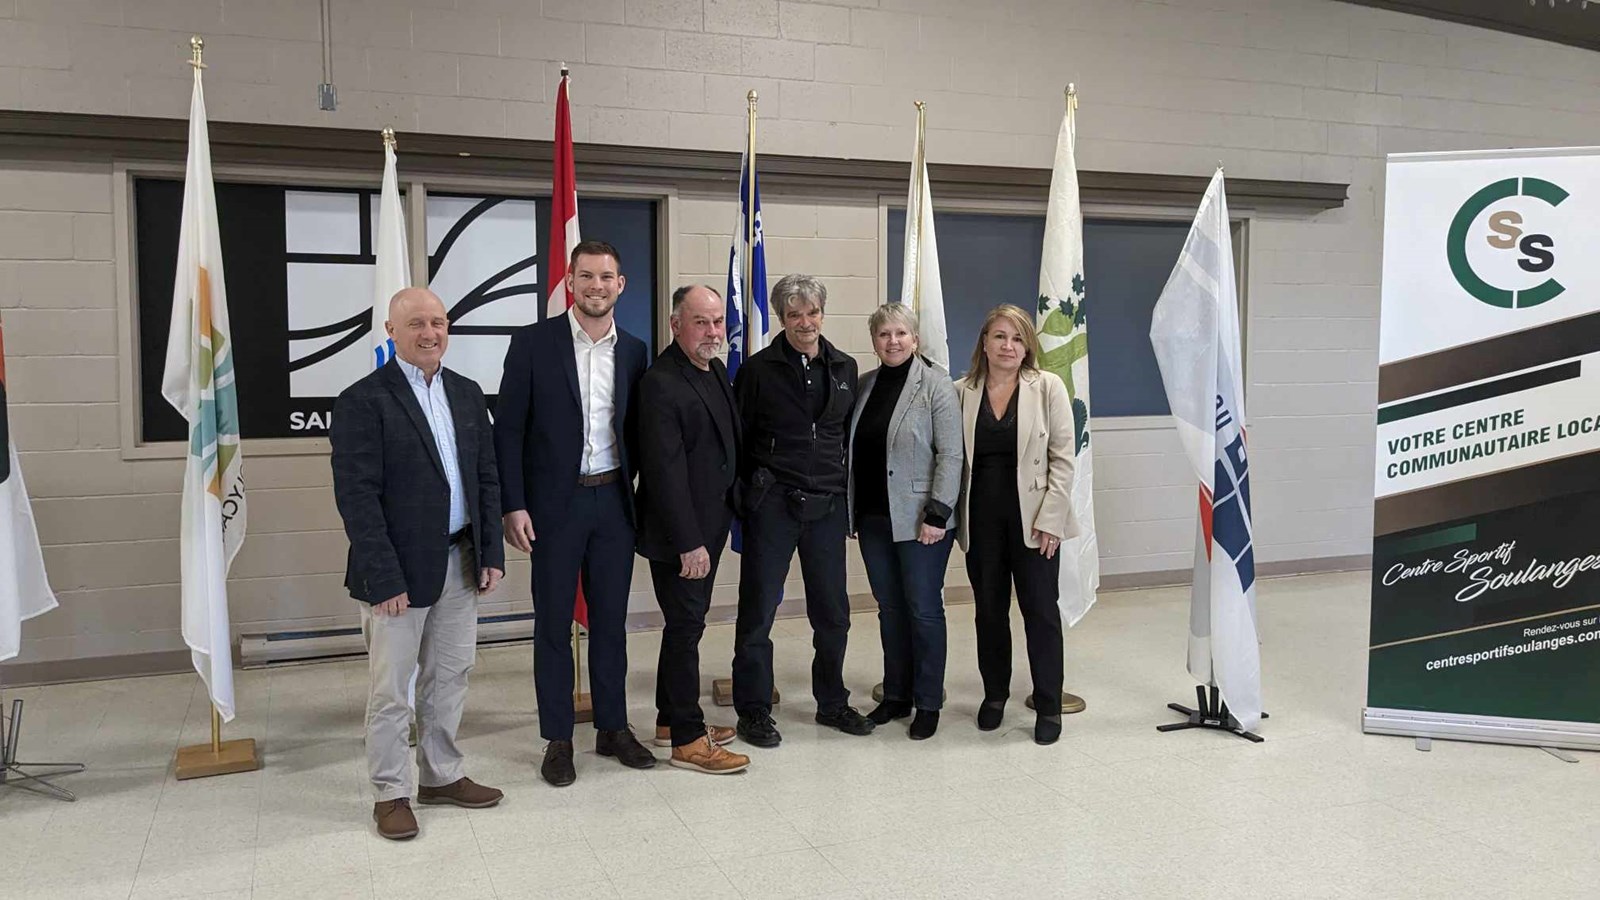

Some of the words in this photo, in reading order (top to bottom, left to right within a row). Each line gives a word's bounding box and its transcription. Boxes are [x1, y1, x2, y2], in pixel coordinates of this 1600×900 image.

[1387, 427, 1446, 455] VOTRE
[1452, 409, 1525, 440] CENTRE
[1387, 426, 1551, 479] COMMUNAUTAIRE
[1382, 558, 1443, 586] Centre
[1444, 540, 1516, 574] Sportif
[1455, 553, 1600, 602] Soulanges
[1523, 619, 1581, 637] Rendez-vous
[1582, 616, 1598, 626] sur
